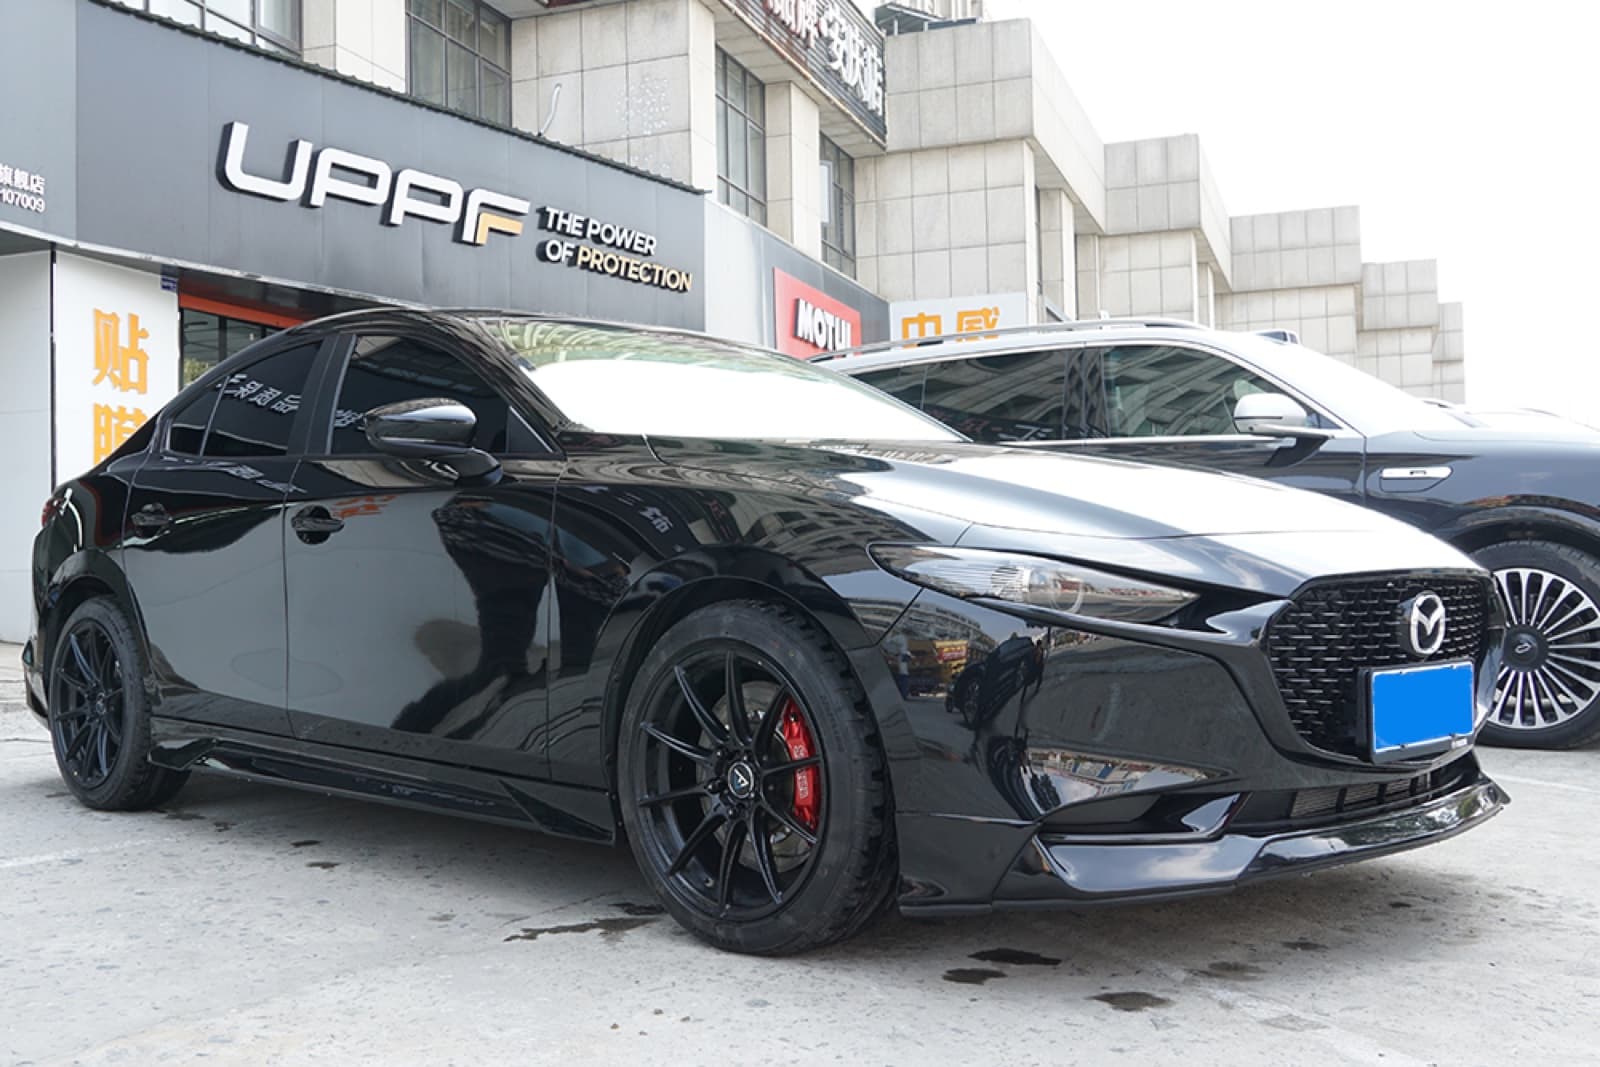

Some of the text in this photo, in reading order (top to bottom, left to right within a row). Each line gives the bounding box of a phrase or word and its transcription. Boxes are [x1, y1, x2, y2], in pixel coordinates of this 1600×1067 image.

[0, 163, 46, 195] 旗舰店
[224, 120, 531, 246] UPPF
[545, 205, 658, 256] THE POWER
[545, 239, 693, 292] OF PROTECTION
